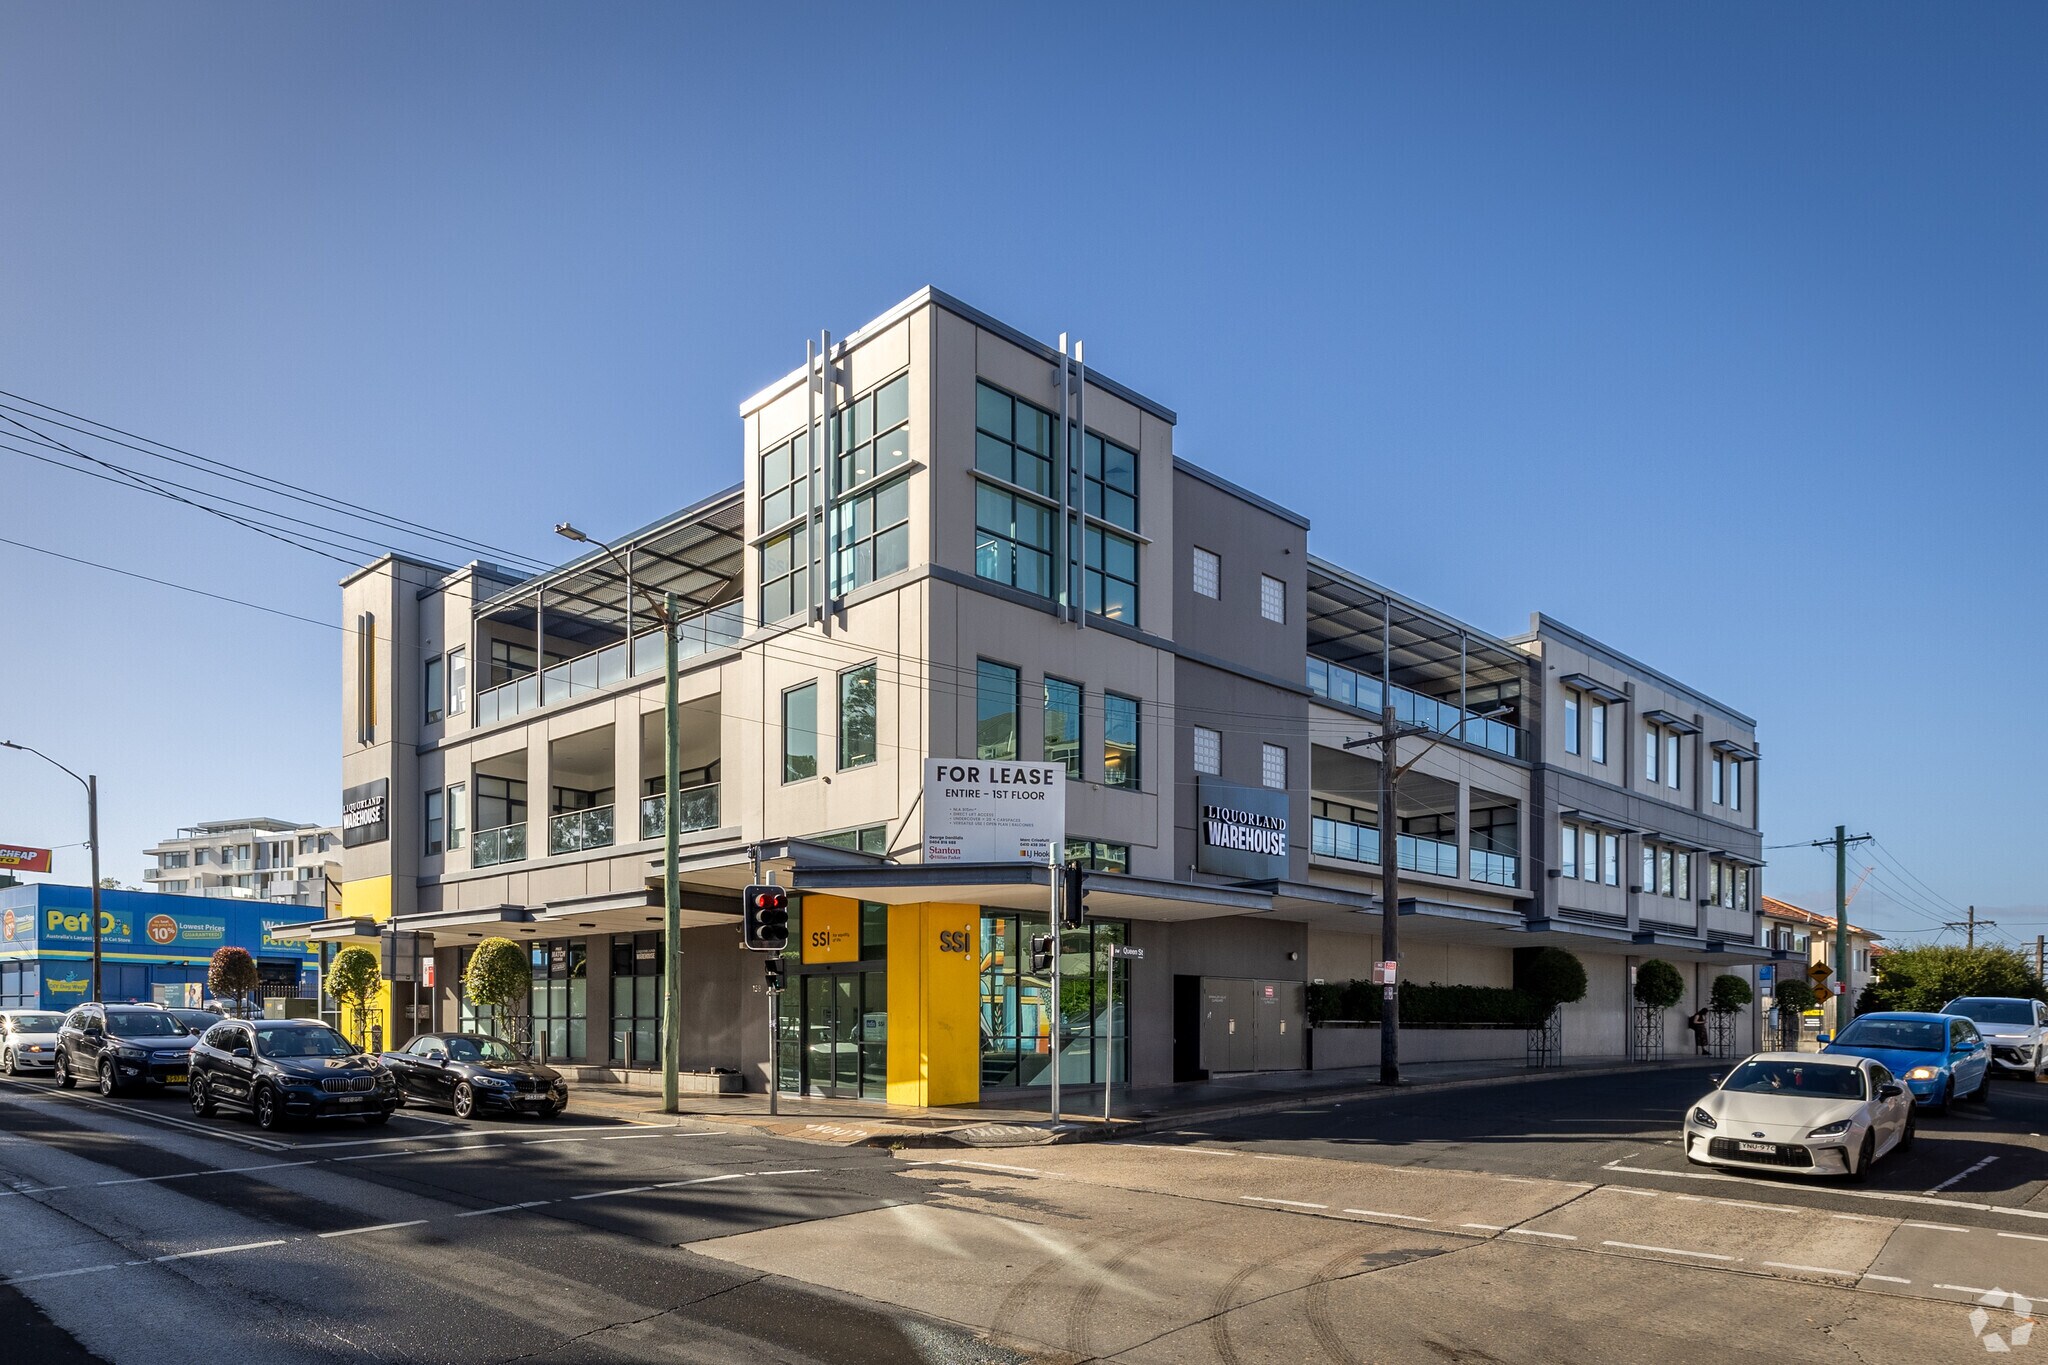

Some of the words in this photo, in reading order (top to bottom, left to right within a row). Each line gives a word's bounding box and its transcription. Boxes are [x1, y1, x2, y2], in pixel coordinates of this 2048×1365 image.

[937, 766, 980, 783] FOR
[990, 768, 1053, 785] LEASE
[946, 789, 980, 798] ENTIRE
[993, 790, 1008, 799] 1ST
[1011, 791, 1044, 800] FLOOR
[343, 806, 381, 830] WAREHOUSE
[1208, 805, 1286, 830] LIQUORLAND
[1208, 821, 1286, 856] WAREHOUSE
[929, 846, 961, 854] Stanton
[153, 928, 175, 940] 10%
[812, 931, 830, 947] SSI
[940, 930, 970, 952] SSI
[1123, 946, 1138, 955] Queen
